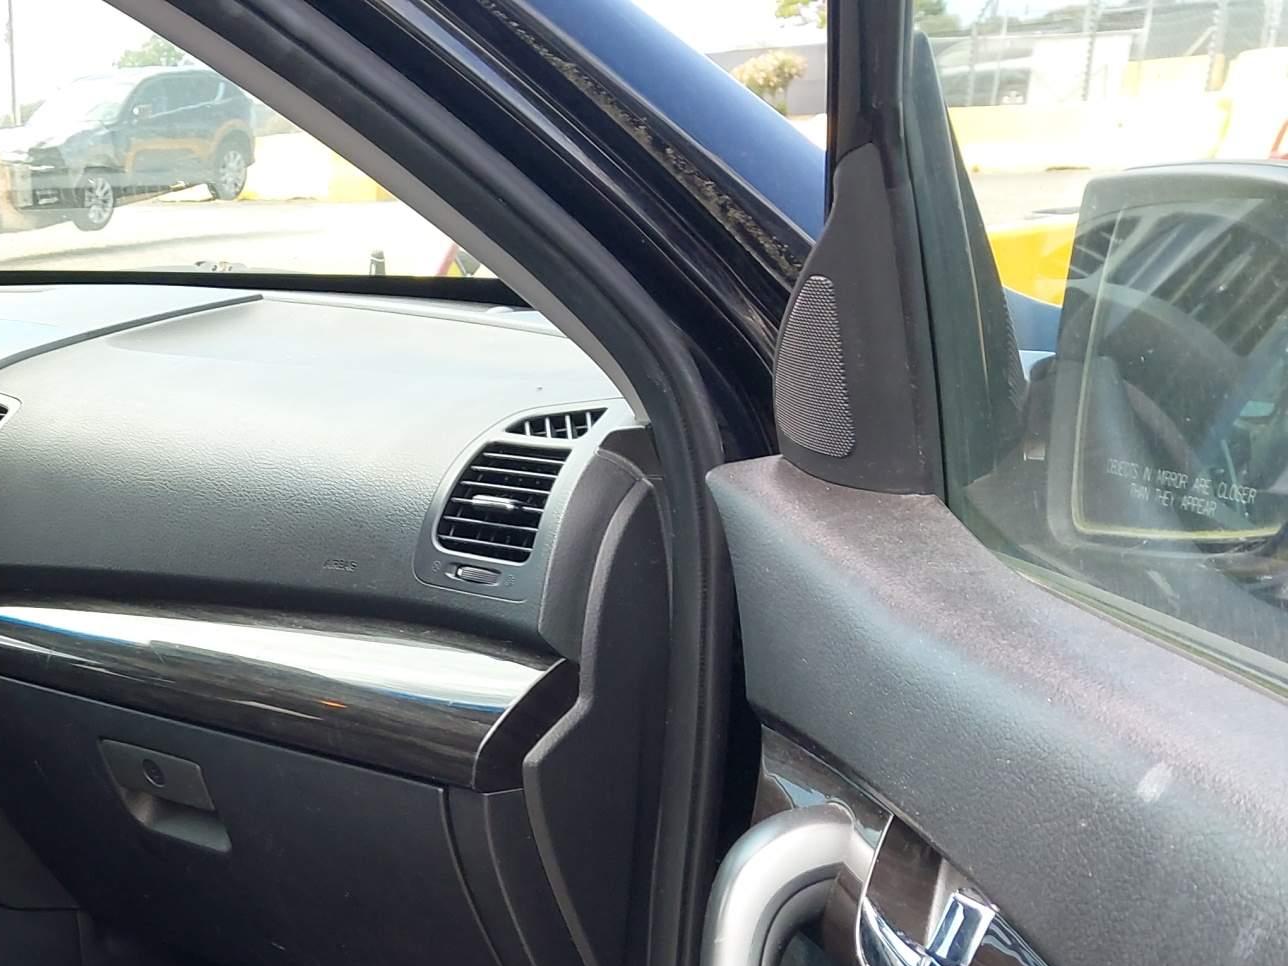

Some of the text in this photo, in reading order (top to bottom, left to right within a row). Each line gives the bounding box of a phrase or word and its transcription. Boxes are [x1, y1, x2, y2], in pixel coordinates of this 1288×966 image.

[1130, 484, 1217, 518] THAN THEY APPEAR
[1143, 467, 1152, 481] IN
[1158, 470, 1188, 489] MIRROR
[1193, 479, 1212, 495] ARE
[1218, 482, 1257, 504] CLOSER
